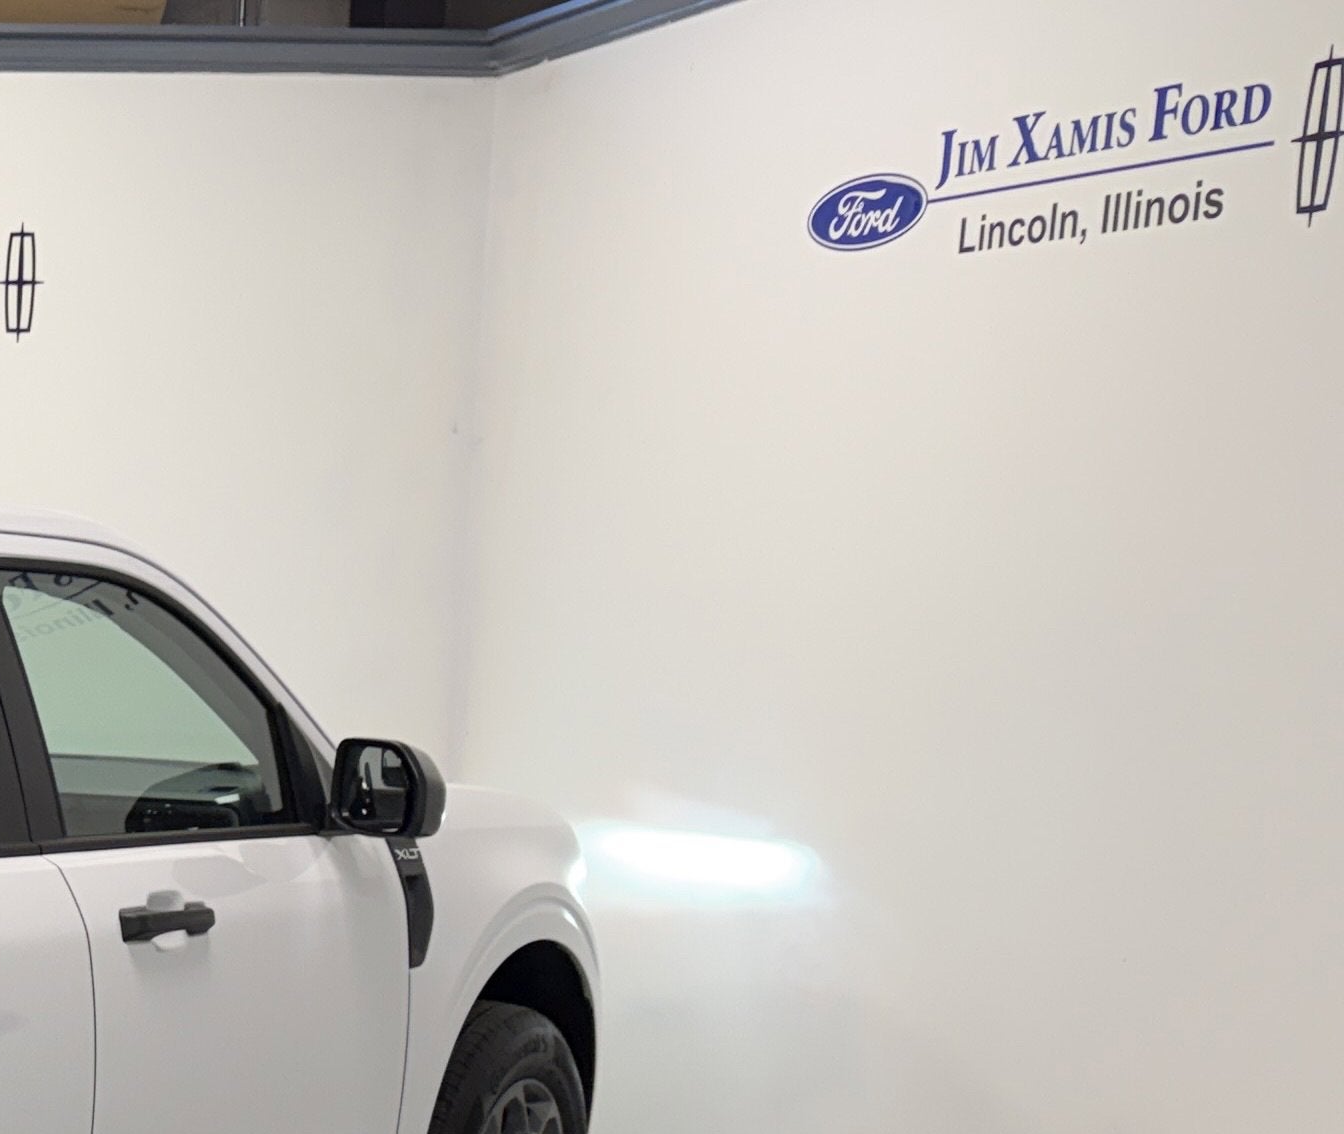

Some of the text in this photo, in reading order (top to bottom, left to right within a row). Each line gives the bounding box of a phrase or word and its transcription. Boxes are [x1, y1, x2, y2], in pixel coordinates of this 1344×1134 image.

[1148, 82, 1273, 143] FORD
[828, 188, 904, 240] Ford
[958, 180, 1224, 254] Lincoln, Illinois
